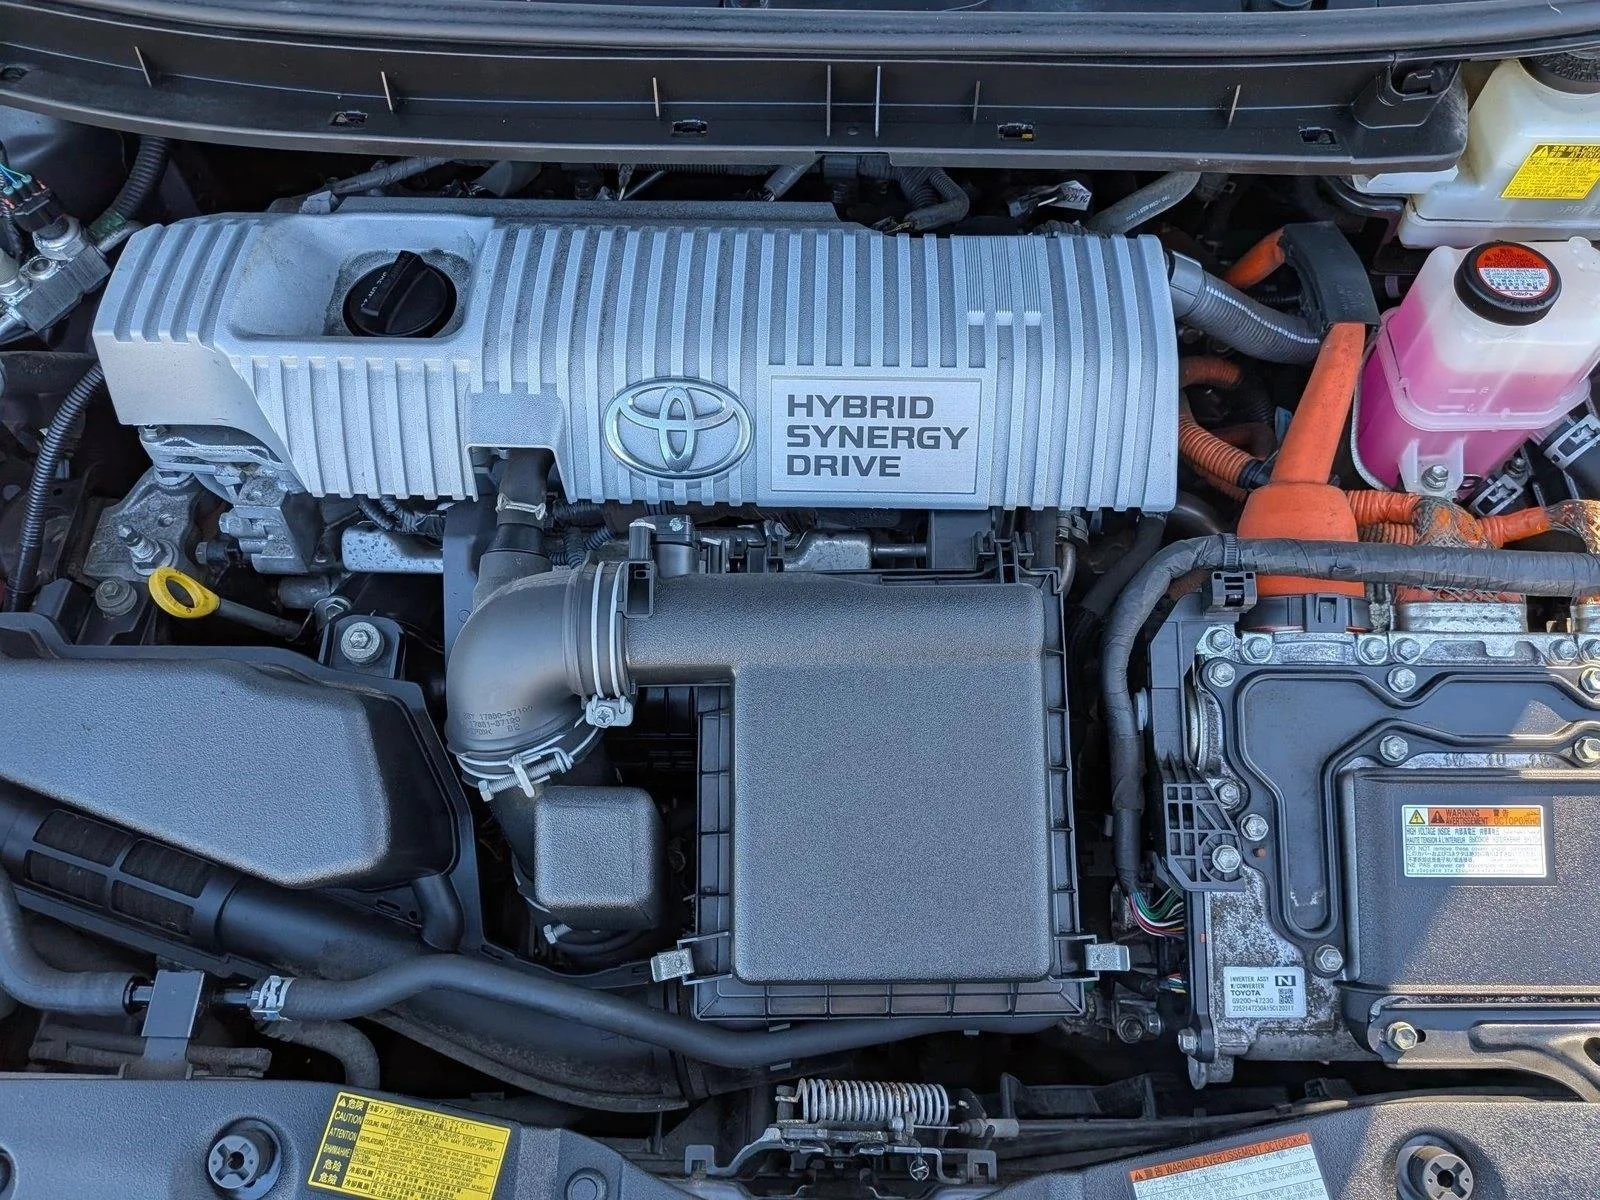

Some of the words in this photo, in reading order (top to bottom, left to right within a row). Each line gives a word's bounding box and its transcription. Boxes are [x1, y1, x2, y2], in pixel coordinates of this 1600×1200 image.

[787, 394, 934, 419] HYBRID
[786, 424, 970, 450] SYNERGY
[786, 454, 901, 477] DRIVE
[1445, 817, 1489, 825] AVERTISSEMENT
[333, 1110, 363, 1125] CAUTION
[328, 1126, 357, 1141] ATTENTION
[1165, 1158, 1201, 1173] WARNING
[1202, 1144, 1262, 1166] AVERTISSEMENT
